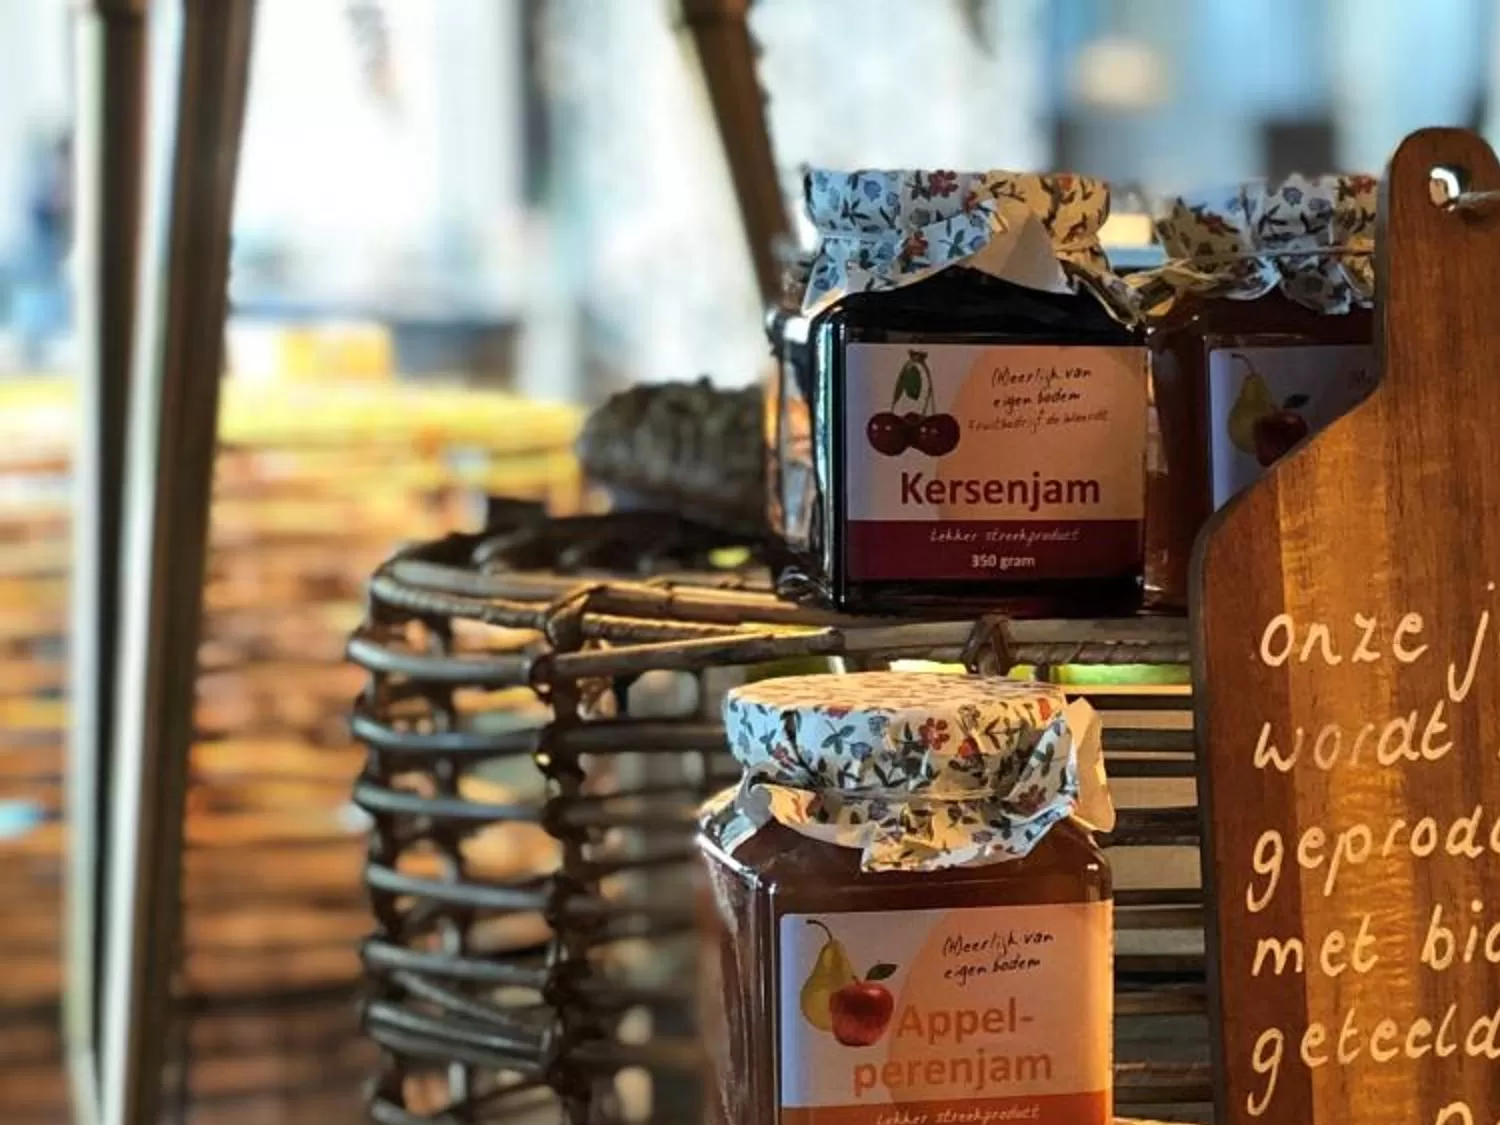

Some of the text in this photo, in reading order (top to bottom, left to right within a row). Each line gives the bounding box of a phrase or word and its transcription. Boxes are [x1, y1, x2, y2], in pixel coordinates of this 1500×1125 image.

[1065, 367, 1092, 378] van
[992, 387, 1082, 415] eigen bodem
[900, 471, 1101, 513] Kersenjam
[970, 554, 1037, 571] 350 gram
[1258, 608, 1430, 668] onze
[1253, 703, 1455, 775] wordt
[1023, 931, 1054, 946] van
[1250, 913, 1381, 979] met
[943, 952, 1042, 988] eigen bodem
[897, 997, 1035, 1044] Appel-
[854, 1048, 1052, 1096] perenjam
